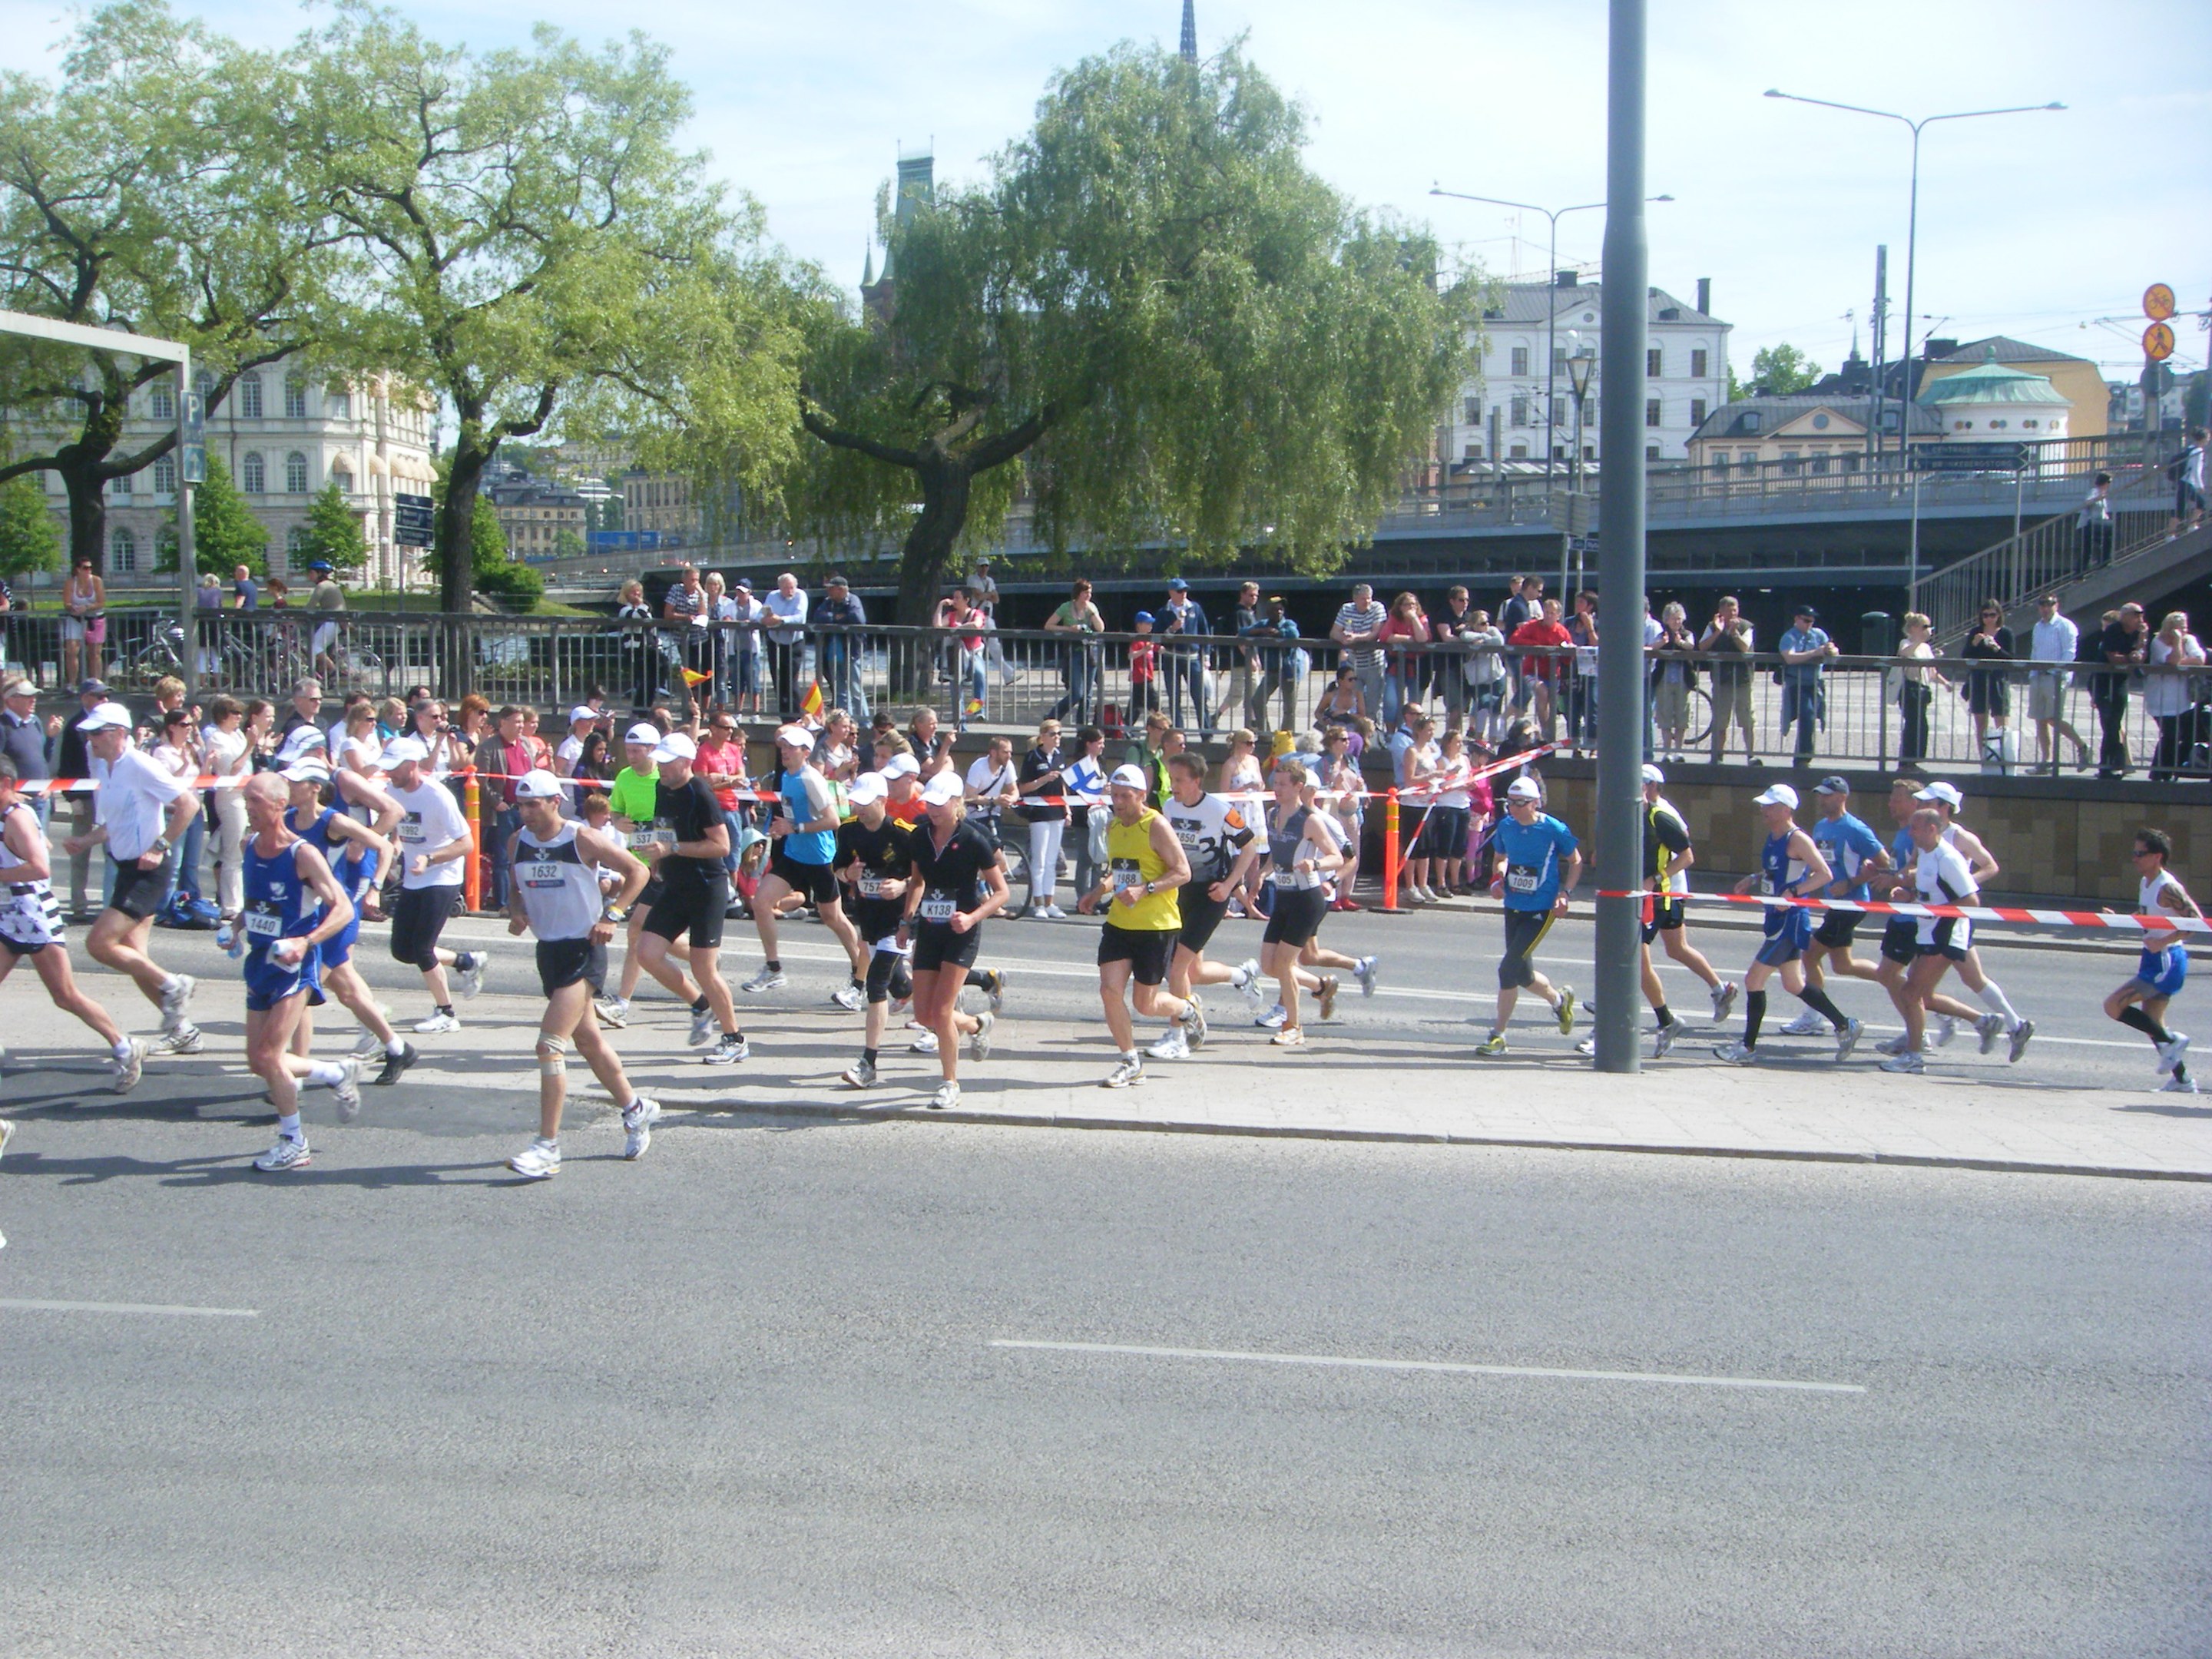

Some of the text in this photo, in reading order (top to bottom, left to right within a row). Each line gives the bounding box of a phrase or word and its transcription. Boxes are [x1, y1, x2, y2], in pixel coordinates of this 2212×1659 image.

[188, 395, 200, 423] P
[636, 833, 652, 844] 537
[531, 865, 558, 878] 1632
[1513, 876, 1534, 889] 1009
[926, 904, 952, 916] K138
[250, 917, 276, 933] 1440
